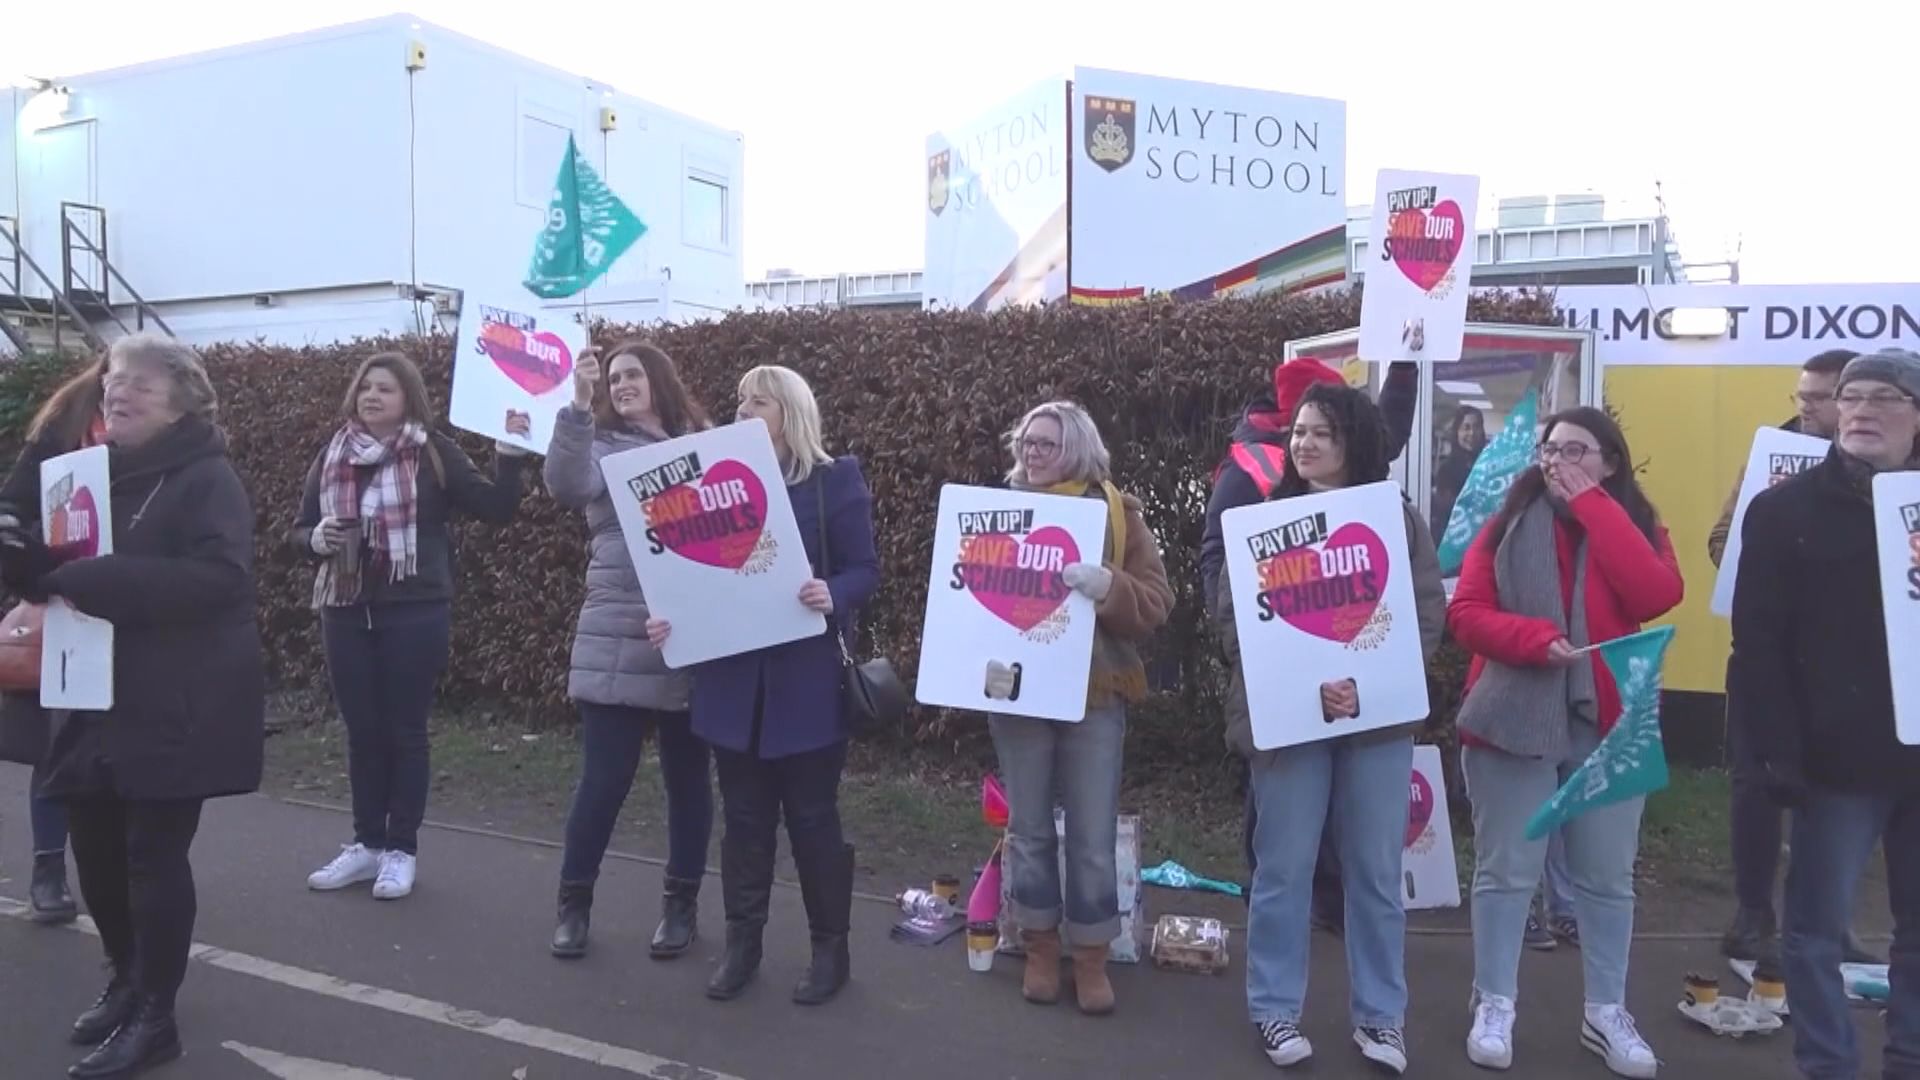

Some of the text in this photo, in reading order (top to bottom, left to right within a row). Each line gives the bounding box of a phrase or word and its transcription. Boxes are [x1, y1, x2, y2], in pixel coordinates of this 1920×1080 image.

[953, 102, 1049, 174] MYTON
[1147, 104, 1319, 152] MYTON
[1146, 146, 1337, 197] SCHOOL
[1389, 186, 1437, 212] PAY UP!
[1387, 213, 1454, 240] SAVE OUR
[1382, 236, 1456, 263] SCHOOLS
[1765, 305, 1920, 339] DIXON
[526, 336, 561, 366] OUR
[630, 451, 704, 499] PAY UP!
[1771, 455, 1802, 475] PAY
[640, 478, 749, 527] SAVE OUR
[960, 509, 1034, 534] PAY UP!
[645, 503, 761, 555] SCHOOLS
[1249, 512, 1328, 561] PAY UP!
[958, 537, 1064, 571] SAVE OUR
[1257, 543, 1371, 590] SAVE OUR
[950, 562, 1069, 600] SCHOOLS
[1257, 571, 1379, 622] SCHOOLS
